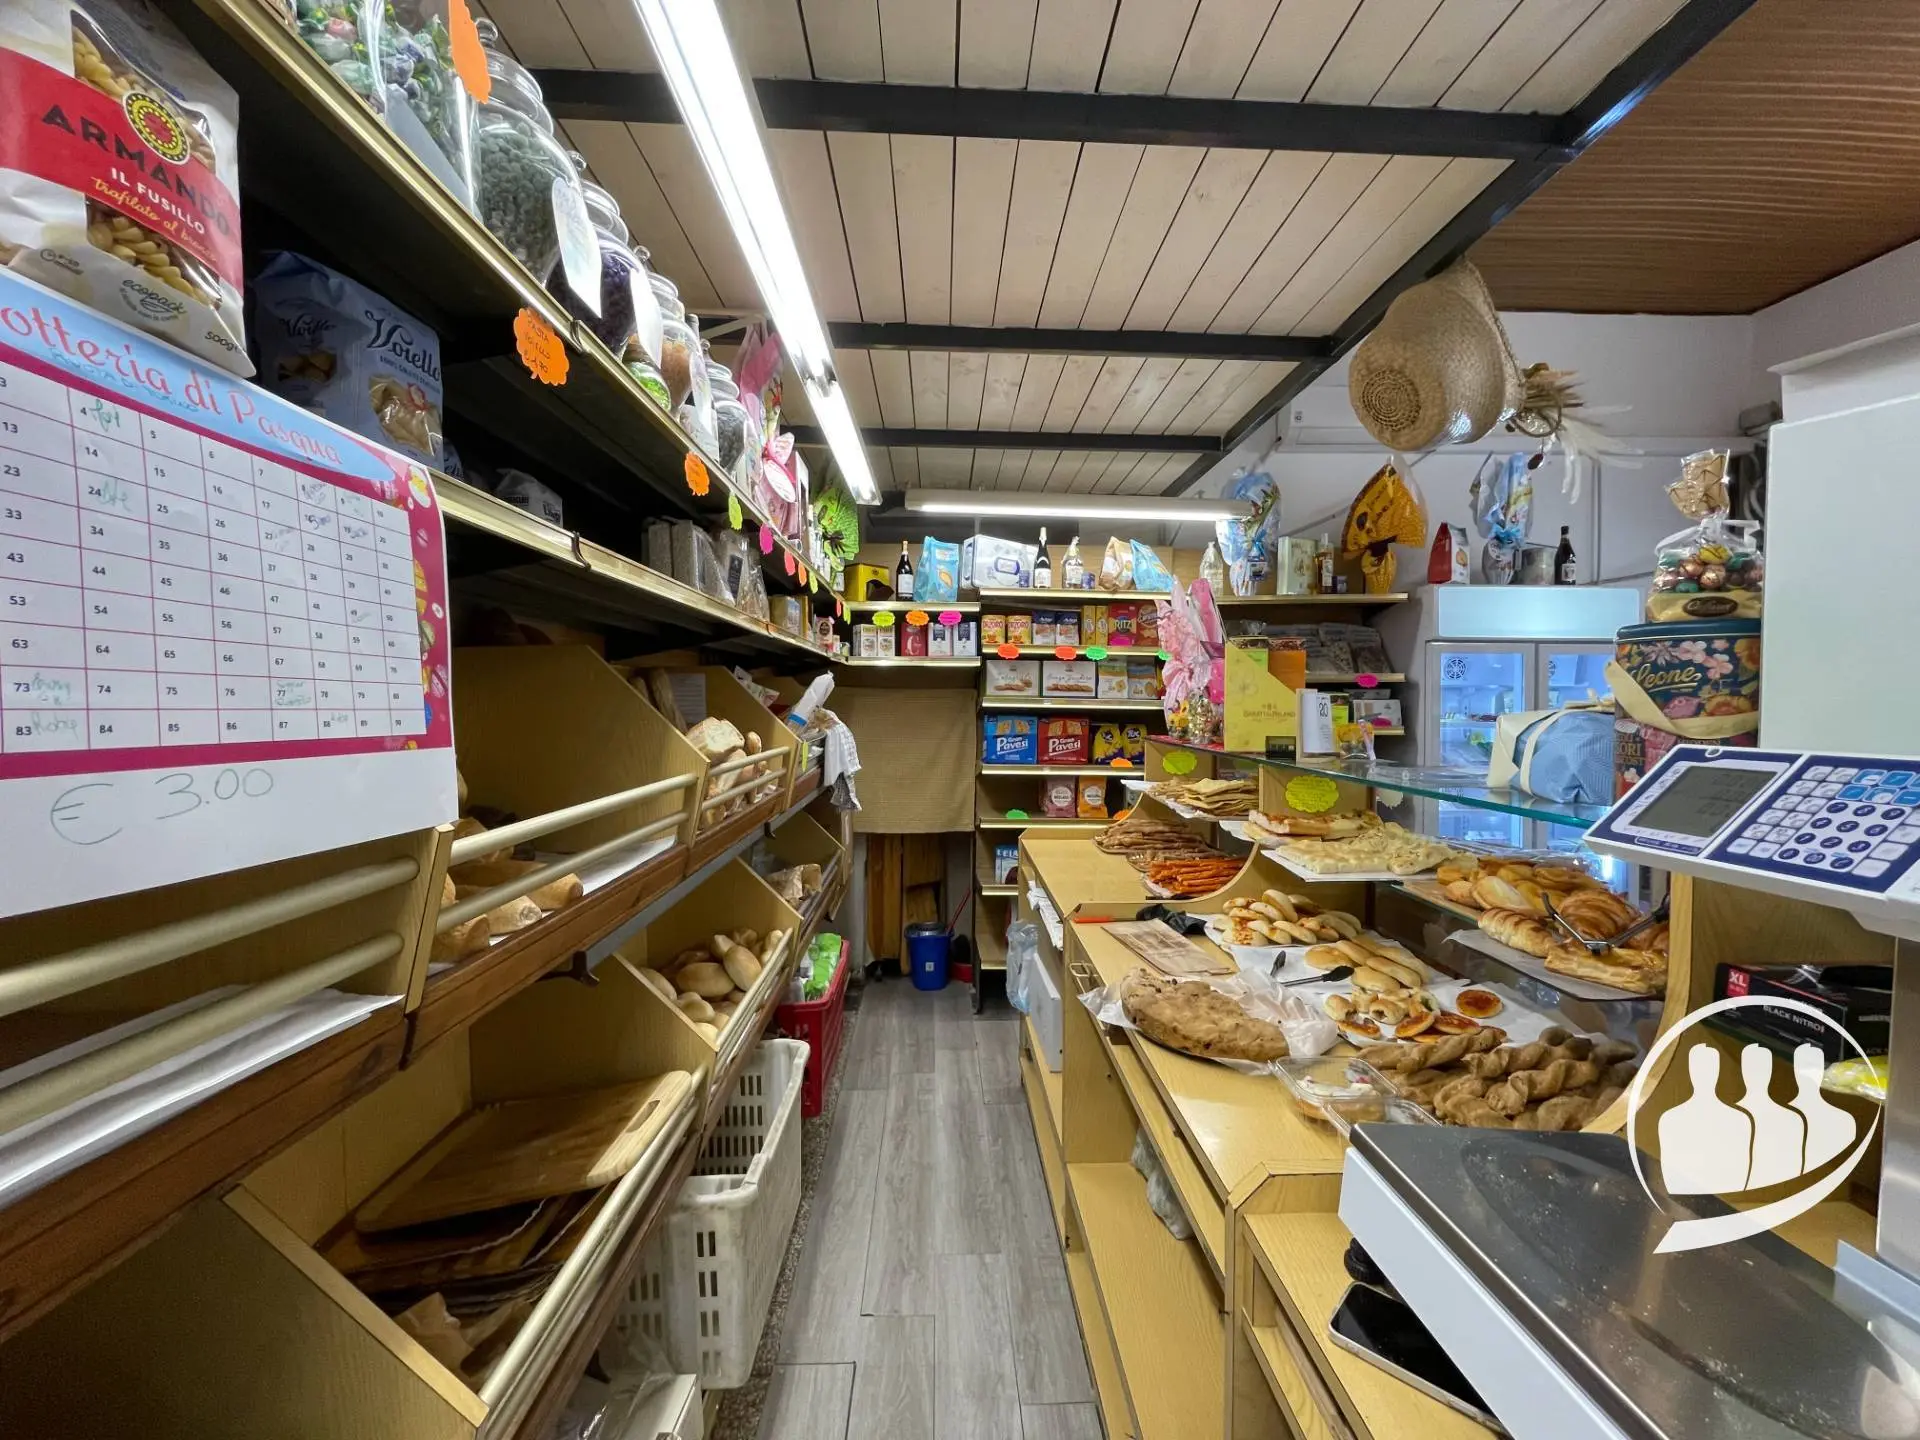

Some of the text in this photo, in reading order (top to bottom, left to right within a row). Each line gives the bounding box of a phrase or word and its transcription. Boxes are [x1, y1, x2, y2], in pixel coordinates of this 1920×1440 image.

[41, 104, 231, 236] ARMANDO
[110, 166, 205, 234] IL FUSILLO
[90, 176, 160, 221] trafilato
[163, 218, 178, 237] al
[121, 278, 188, 315] ecopack
[364, 309, 440, 380] Voiello
[184, 368, 223, 416] di
[228, 389, 343, 465] Pasqua
[2, 421, 19, 434] 13
[84, 446, 99, 457] 14
[3, 464, 21, 477] 23
[154, 467, 166, 477] 15
[88, 486, 102, 497] 24
[212, 485, 223, 495] 16
[157, 503, 169, 514] 25
[5, 508, 22, 520] 33
[90, 525, 104, 536] 34
[159, 540, 170, 550] 35
[6, 552, 24, 563] 43
[217, 552, 228, 562] 36
[92, 566, 106, 576] 44
[160, 577, 172, 587] 45
[219, 586, 231, 596] 46
[9, 595, 26, 606] 53
[93, 605, 108, 615] 54
[162, 613, 174, 623] 55
[221, 620, 232, 629] 56
[1114, 618, 1132, 631] RITZ
[272, 626, 282, 635] 57
[11, 639, 28, 649] 63
[95, 645, 110, 655] 64
[164, 650, 176, 659] 65
[223, 654, 234, 663] 66
[274, 657, 284, 666] 67
[13, 682, 31, 693] 73
[97, 684, 111, 694] 74
[166, 687, 178, 696] 75
[224, 688, 236, 697] 76
[1318, 702, 1329, 718] 20
[99, 725, 113, 734] 84
[168, 723, 180, 732] 85
[226, 722, 237, 730] 86
[278, 721, 288, 729] 87
[15, 726, 33, 736] 83
[997, 737, 1029, 752] Pavesi
[1049, 738, 1081, 754] Pavesi
[50, 767, 274, 845] € 3.00
[1729, 970, 1748, 987] XL
[1762, 1004, 1791, 1021] BLACK
